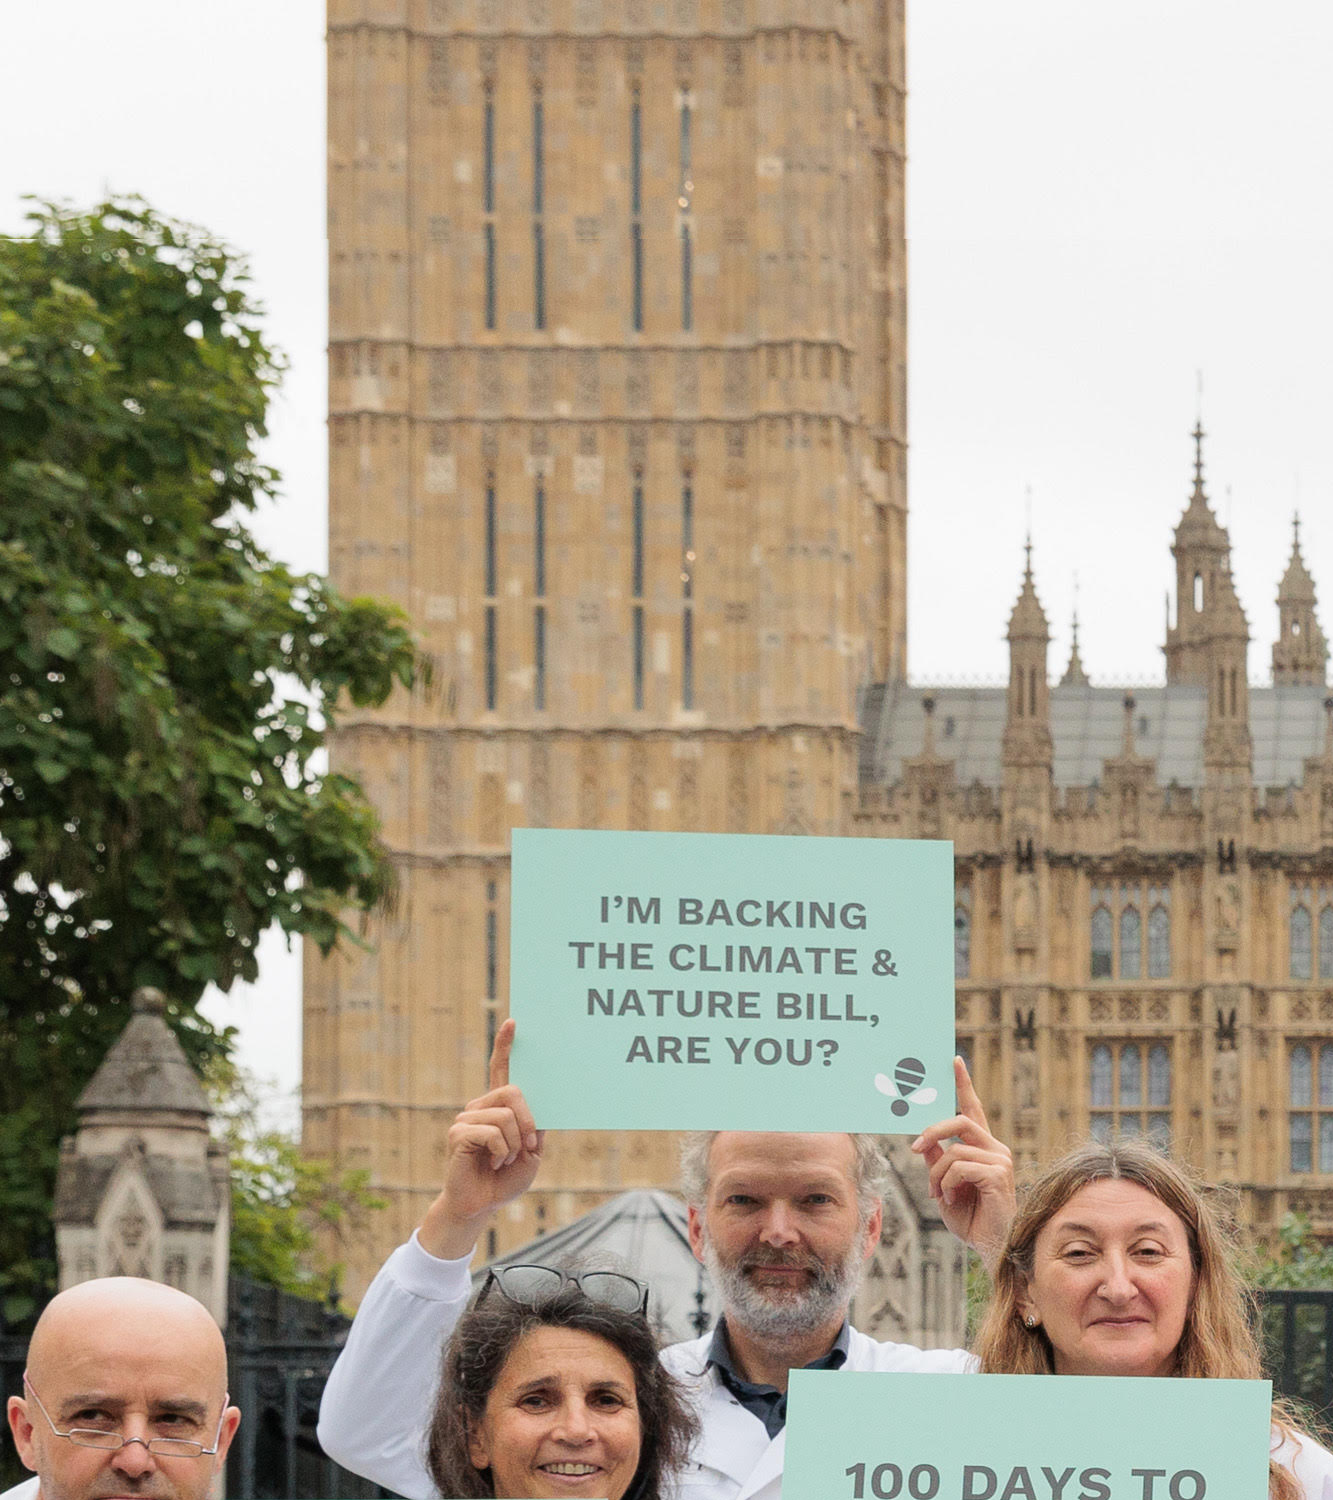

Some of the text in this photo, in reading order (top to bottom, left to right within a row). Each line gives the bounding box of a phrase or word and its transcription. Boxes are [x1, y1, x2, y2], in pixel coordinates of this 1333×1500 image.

[600, 895, 867, 930] I'M BACKING
[568, 941, 898, 977] THE CLIMATE &
[587, 988, 879, 1027] NATURE BILL,
[626, 1035, 839, 1067] ARE YOU?
[845, 1462, 940, 1500] 100
